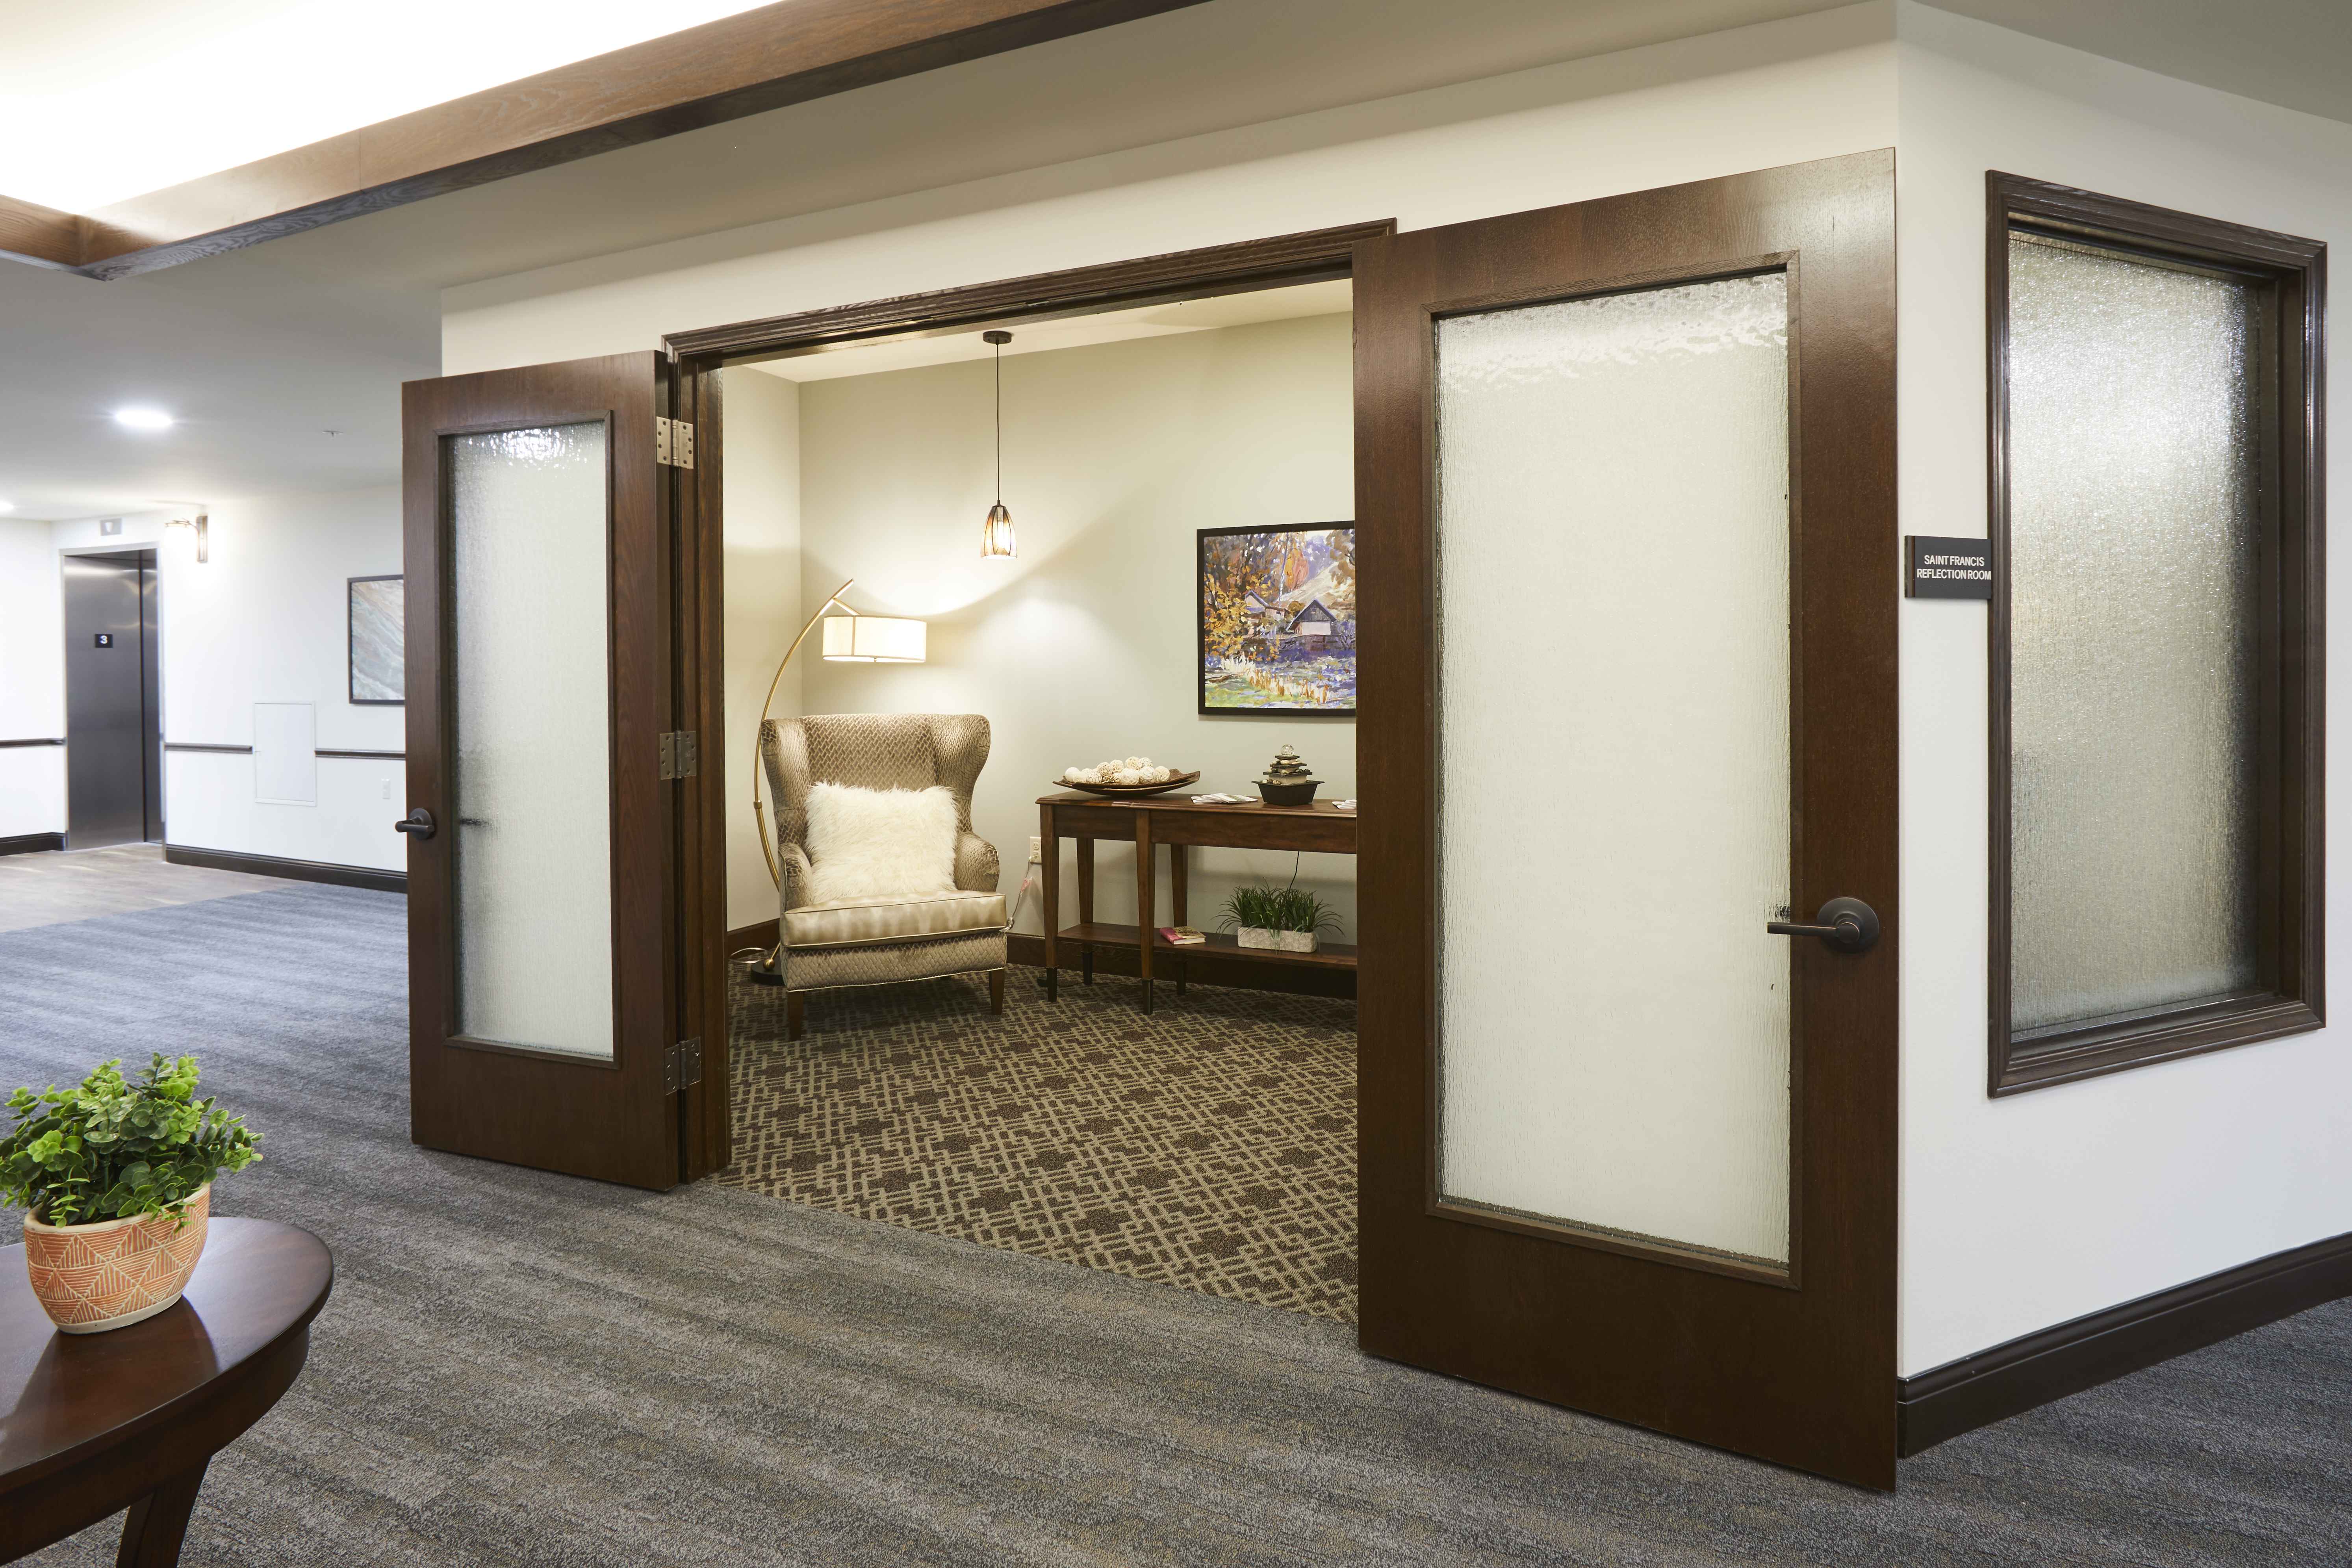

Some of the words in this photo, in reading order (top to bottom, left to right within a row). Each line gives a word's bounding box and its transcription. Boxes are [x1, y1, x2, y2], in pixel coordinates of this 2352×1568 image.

[1924, 555, 1949, 564] SAINT
[1949, 556, 1985, 566] FRANCIS
[1917, 568, 1966, 579] REFLECTION
[1967, 570, 1991, 580] ROOM
[100, 635, 108, 644] 3
